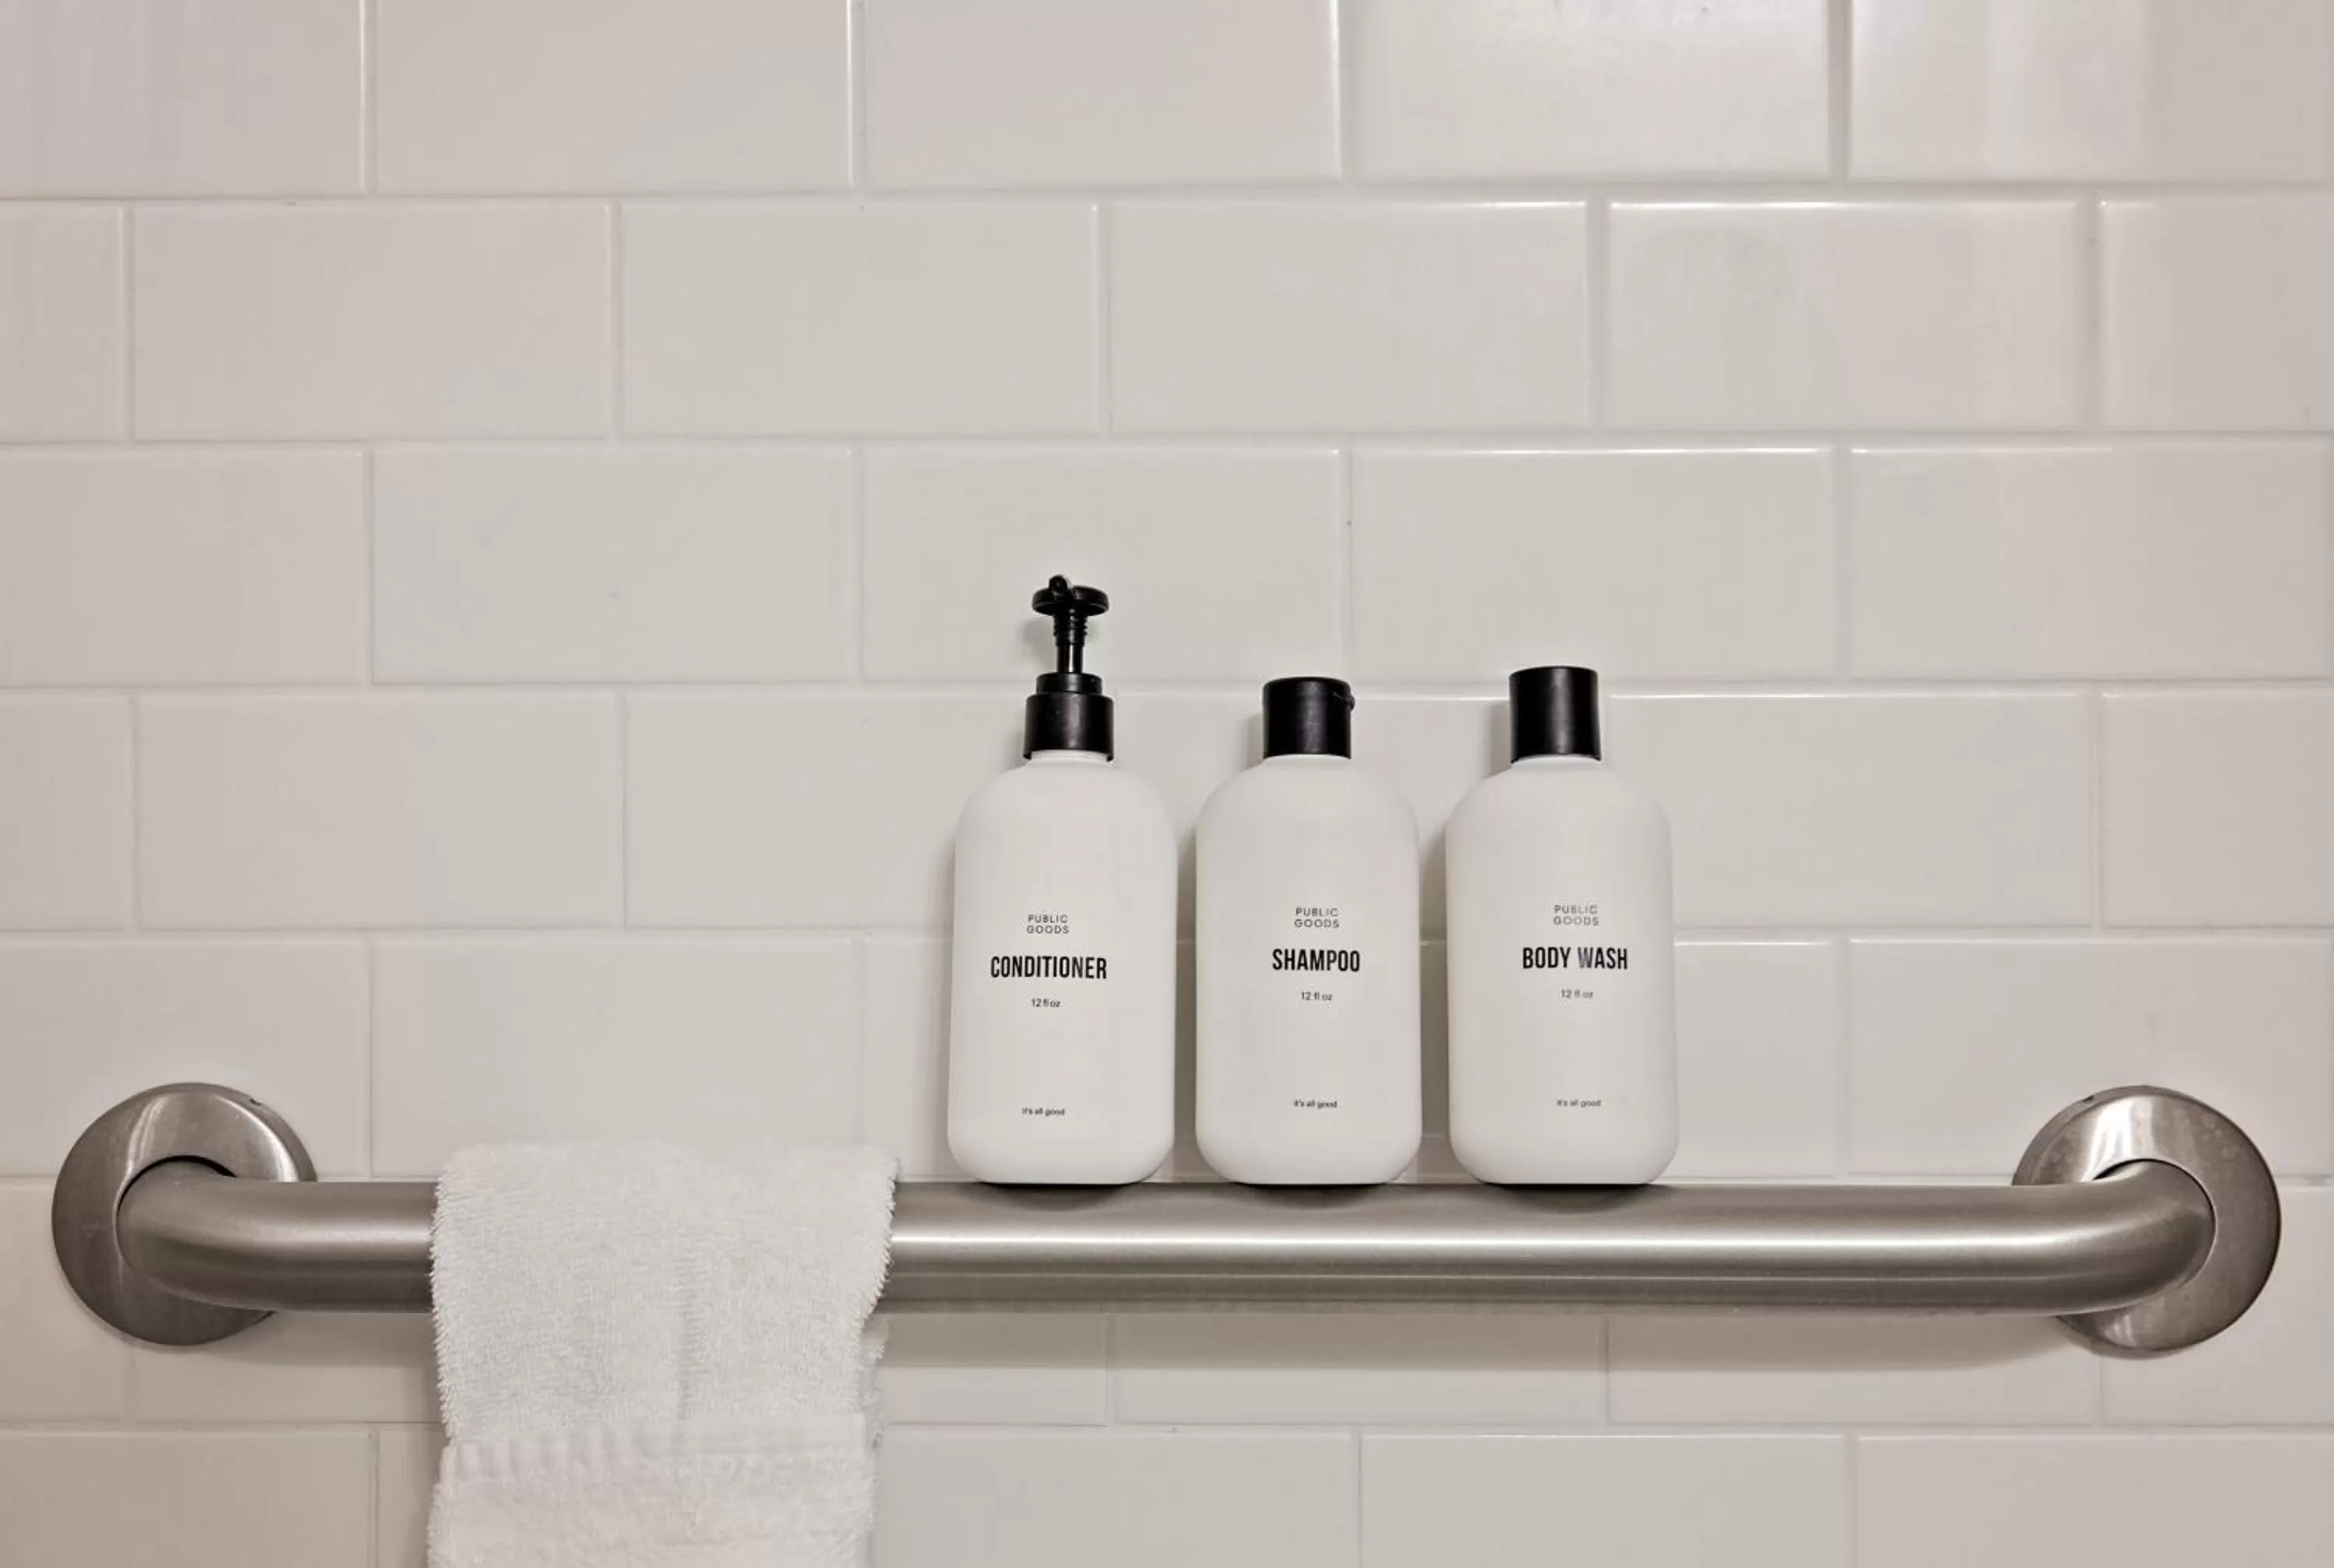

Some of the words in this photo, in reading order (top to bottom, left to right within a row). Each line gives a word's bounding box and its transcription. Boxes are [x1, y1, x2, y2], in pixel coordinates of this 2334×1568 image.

[1295, 907, 1338, 917] PUBLIC
[1554, 905, 1598, 914] PUBLIC
[1027, 914, 1068, 923] PUBLIC
[1553, 916, 1600, 926] GOODS
[1294, 919, 1340, 928] GOODS
[1026, 925, 1070, 934] GOODS
[1271, 947, 1362, 973] SHAMPOO
[1522, 946, 1572, 969] BODY
[1576, 947, 1628, 971] WASH
[990, 955, 1108, 980] CONDITIONER
[1301, 992, 1312, 1001] 12
[1313, 992, 1320, 1001] fl
[1561, 989, 1572, 999] 12
[1031, 998, 1042, 1007] 12
[1306, 1099, 1316, 1108] all
[1317, 1100, 1338, 1110] good
[1580, 1099, 1603, 1108] good
[1045, 1108, 1066, 1117] good
